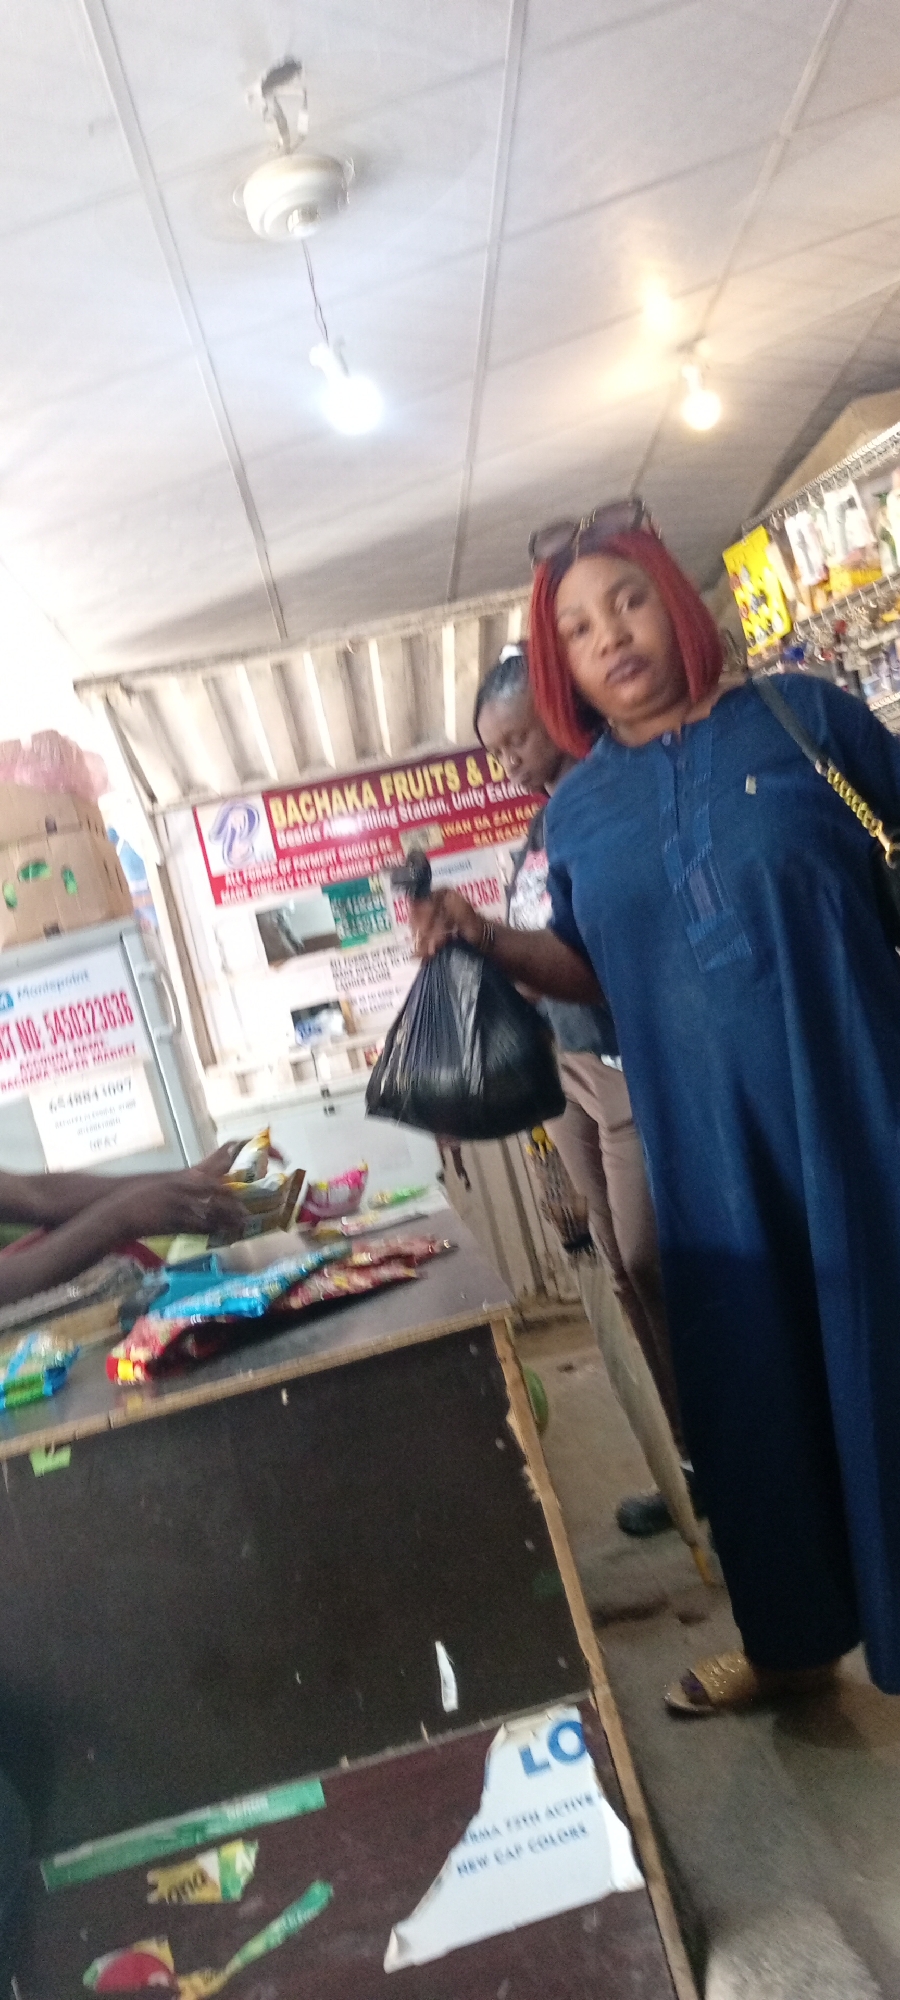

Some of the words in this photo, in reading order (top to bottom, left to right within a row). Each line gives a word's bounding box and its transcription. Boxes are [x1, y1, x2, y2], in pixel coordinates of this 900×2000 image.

[269, 779, 379, 831] BACHAKA
[380, 760, 461, 807] FRUITS
[466, 755, 484, 788] &
[486, 752, 505, 783] D
[398, 798, 451, 824] Station,
[452, 787, 486, 811] Unity
[225, 871, 242, 887] ALL
[243, 860, 278, 884] FORMS
[279, 856, 293, 876] OF
[293, 846, 338, 874] PAYMENT
[338, 839, 379, 862] SHOULD
[250, 872, 293, 897] DIRECTLY
[43, 988, 135, 1046] 5450323636
[92, 1042, 136, 1065] MARKET
[457, 1852, 489, 1877] NEW
